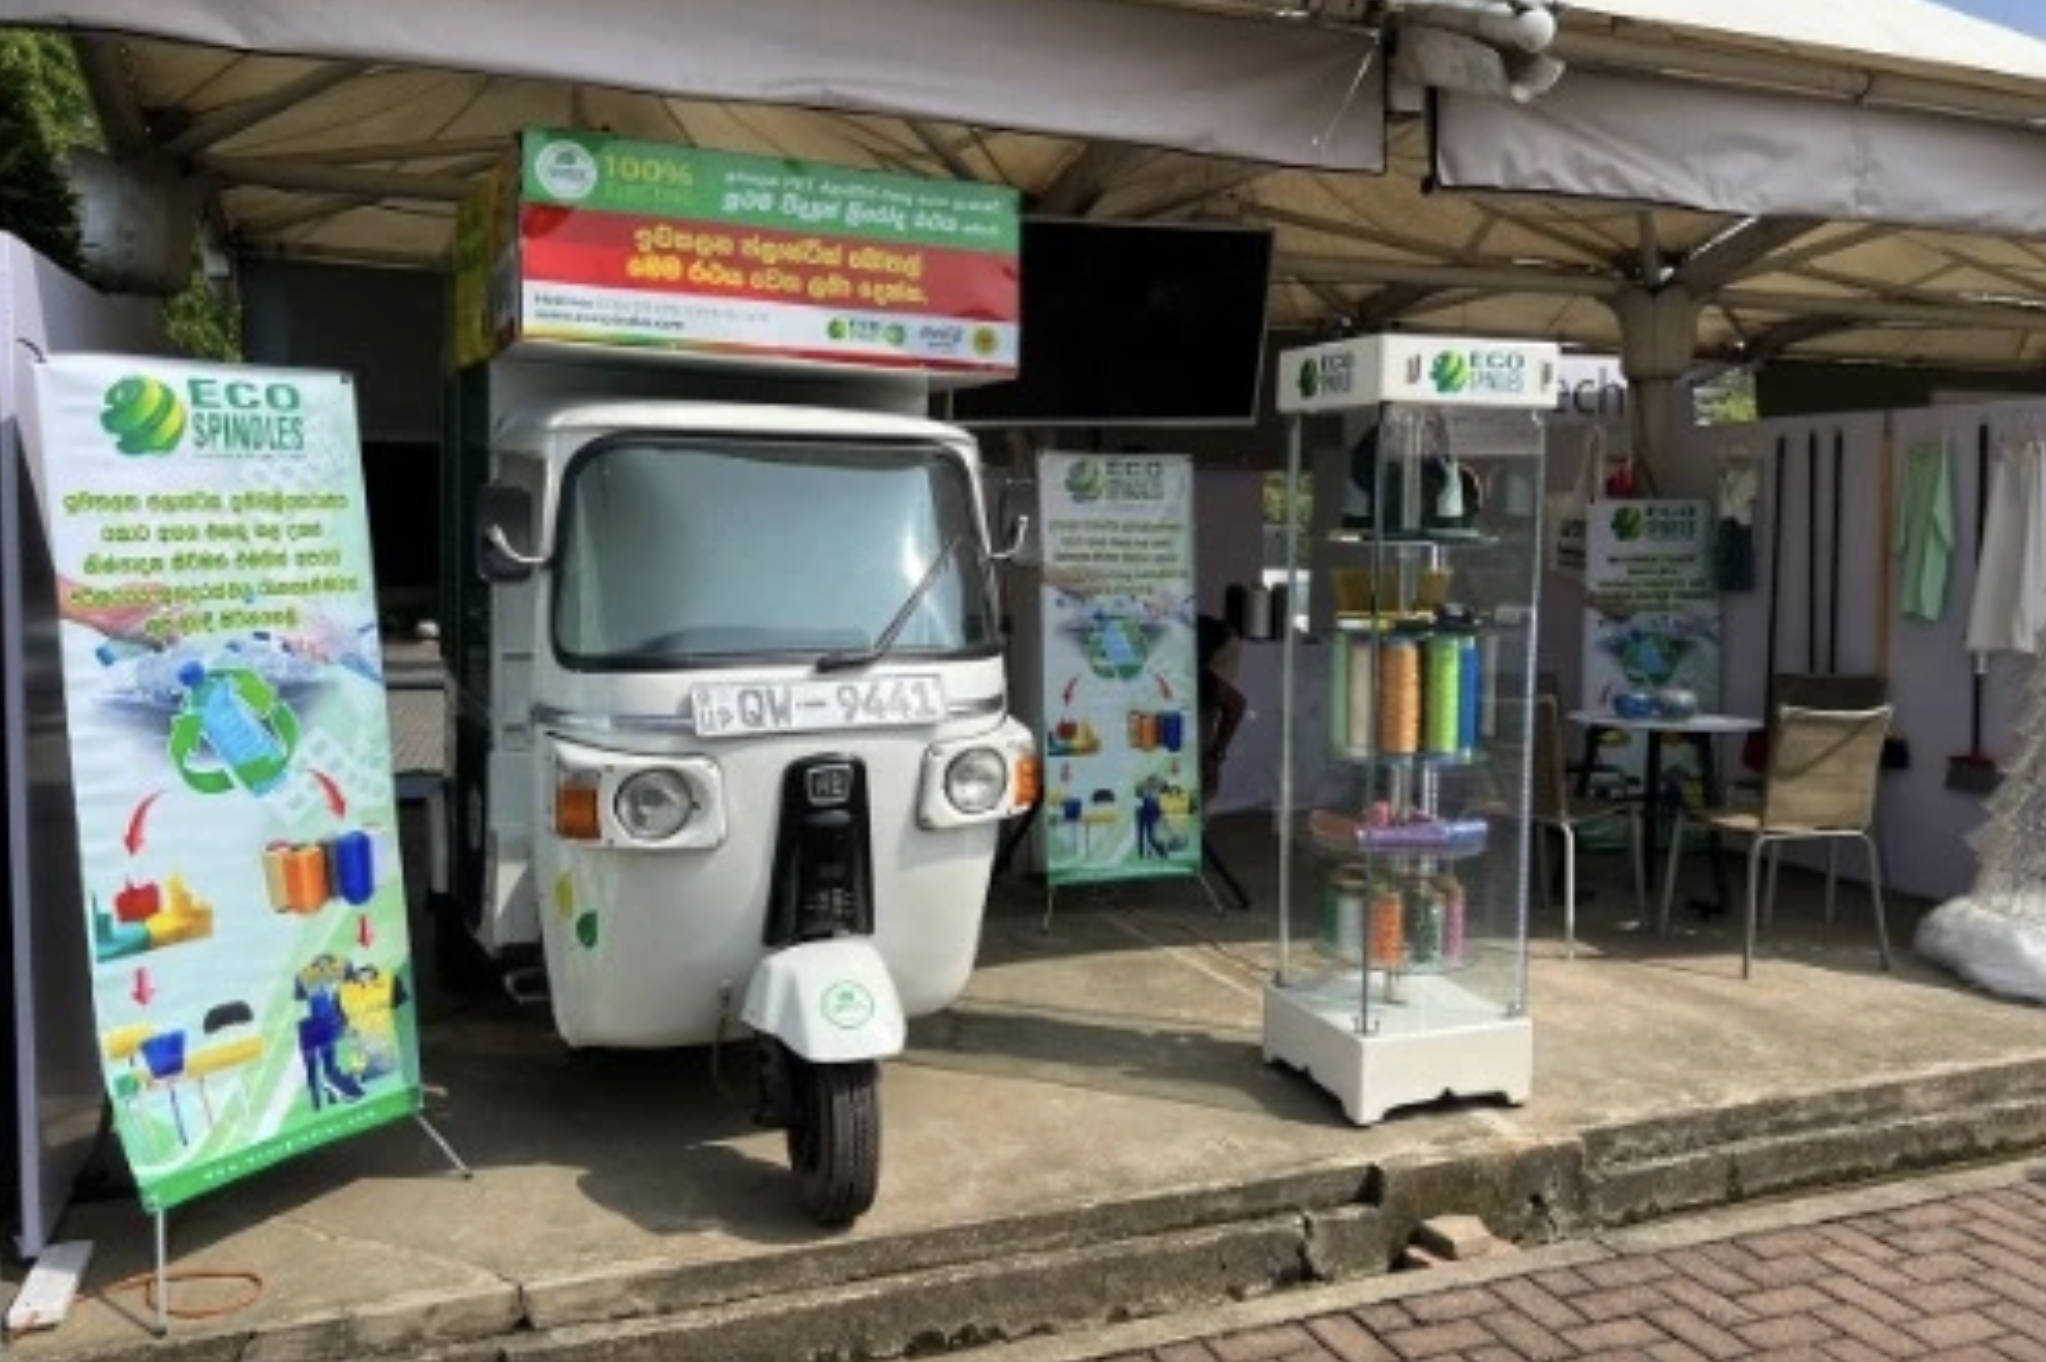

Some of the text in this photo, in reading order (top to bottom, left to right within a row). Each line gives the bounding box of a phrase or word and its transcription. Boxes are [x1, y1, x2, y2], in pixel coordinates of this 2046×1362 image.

[603, 154, 693, 186] 100%
[1469, 351, 1525, 370] ECO
[187, 378, 301, 412] ECO
[191, 411, 304, 451] SPINDLES
